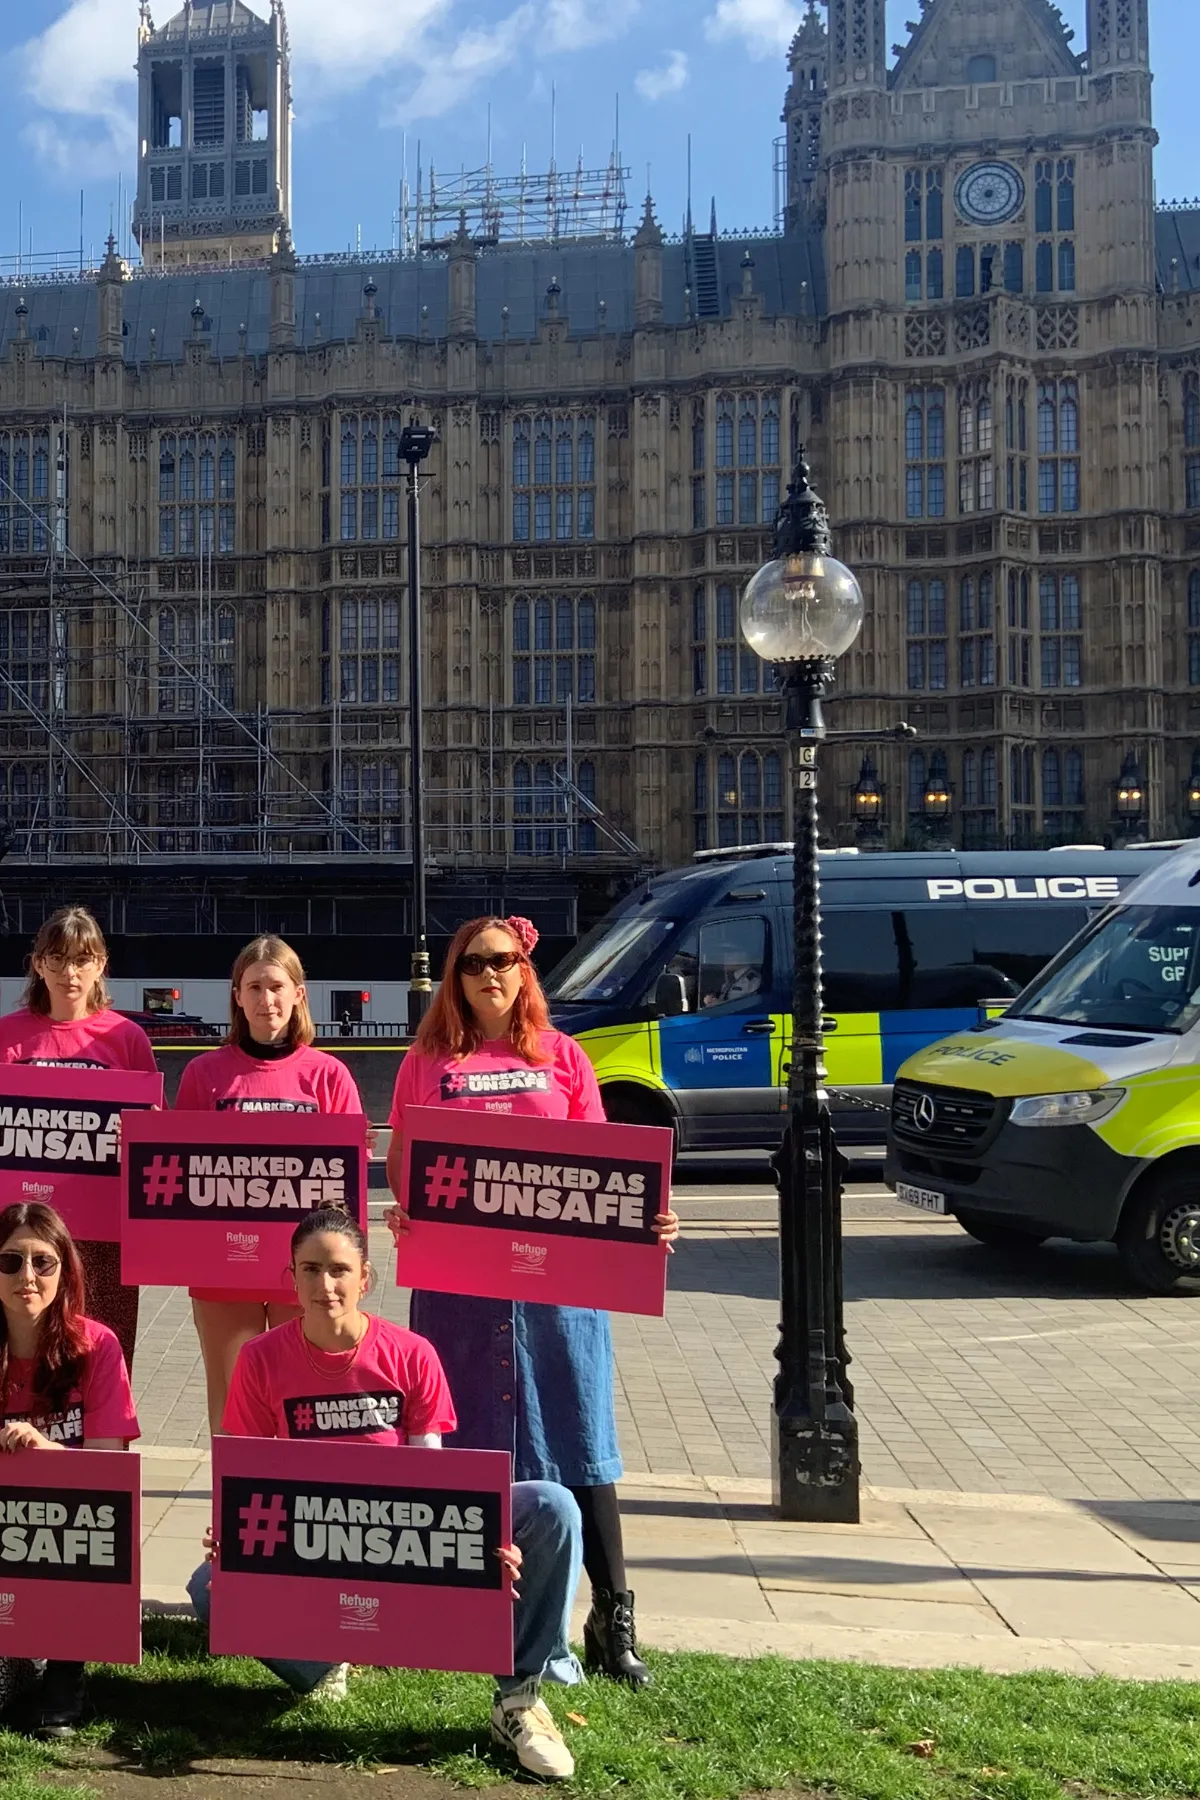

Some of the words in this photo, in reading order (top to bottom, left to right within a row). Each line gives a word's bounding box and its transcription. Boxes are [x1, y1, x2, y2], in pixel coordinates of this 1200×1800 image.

[803, 748, 812, 763] G
[804, 772, 811, 786] 2
[926, 877, 1120, 900] POLICE
[928, 1046, 1017, 1066] POLICE
[468, 1071, 526, 1081] MARKED
[527, 1071, 546, 1079] AS
[468, 1077, 547, 1091] UNSAFE
[242, 1102, 295, 1112] MARKED
[296, 1104, 312, 1113] AS
[485, 1101, 512, 1111] Refuge
[104, 1113, 121, 1132] A
[22, 1181, 54, 1193] Refuge
[143, 1155, 183, 1206] #
[188, 1155, 304, 1177] MARKED
[308, 1157, 345, 1178] AS
[425, 1155, 469, 1209] #
[474, 1158, 600, 1190] MARKED
[604, 1172, 645, 1195] AS
[188, 1177, 345, 1208] UNSAFE
[473, 1181, 644, 1229] UNSAFE
[226, 1231, 259, 1243] Refuge
[511, 1241, 547, 1255] Refuge
[315, 1397, 377, 1412] MARKED
[379, 1396, 398, 1409] AS
[66, 1408, 82, 1421] AS
[316, 1408, 398, 1430] UNSAFE
[72, 1504, 115, 1529] AS
[238, 1493, 287, 1556] #
[294, 1495, 434, 1527] MARKED
[439, 1505, 484, 1532] AS
[293, 1522, 485, 1571] UNSAFE
[339, 1593, 379, 1608] Refuge
